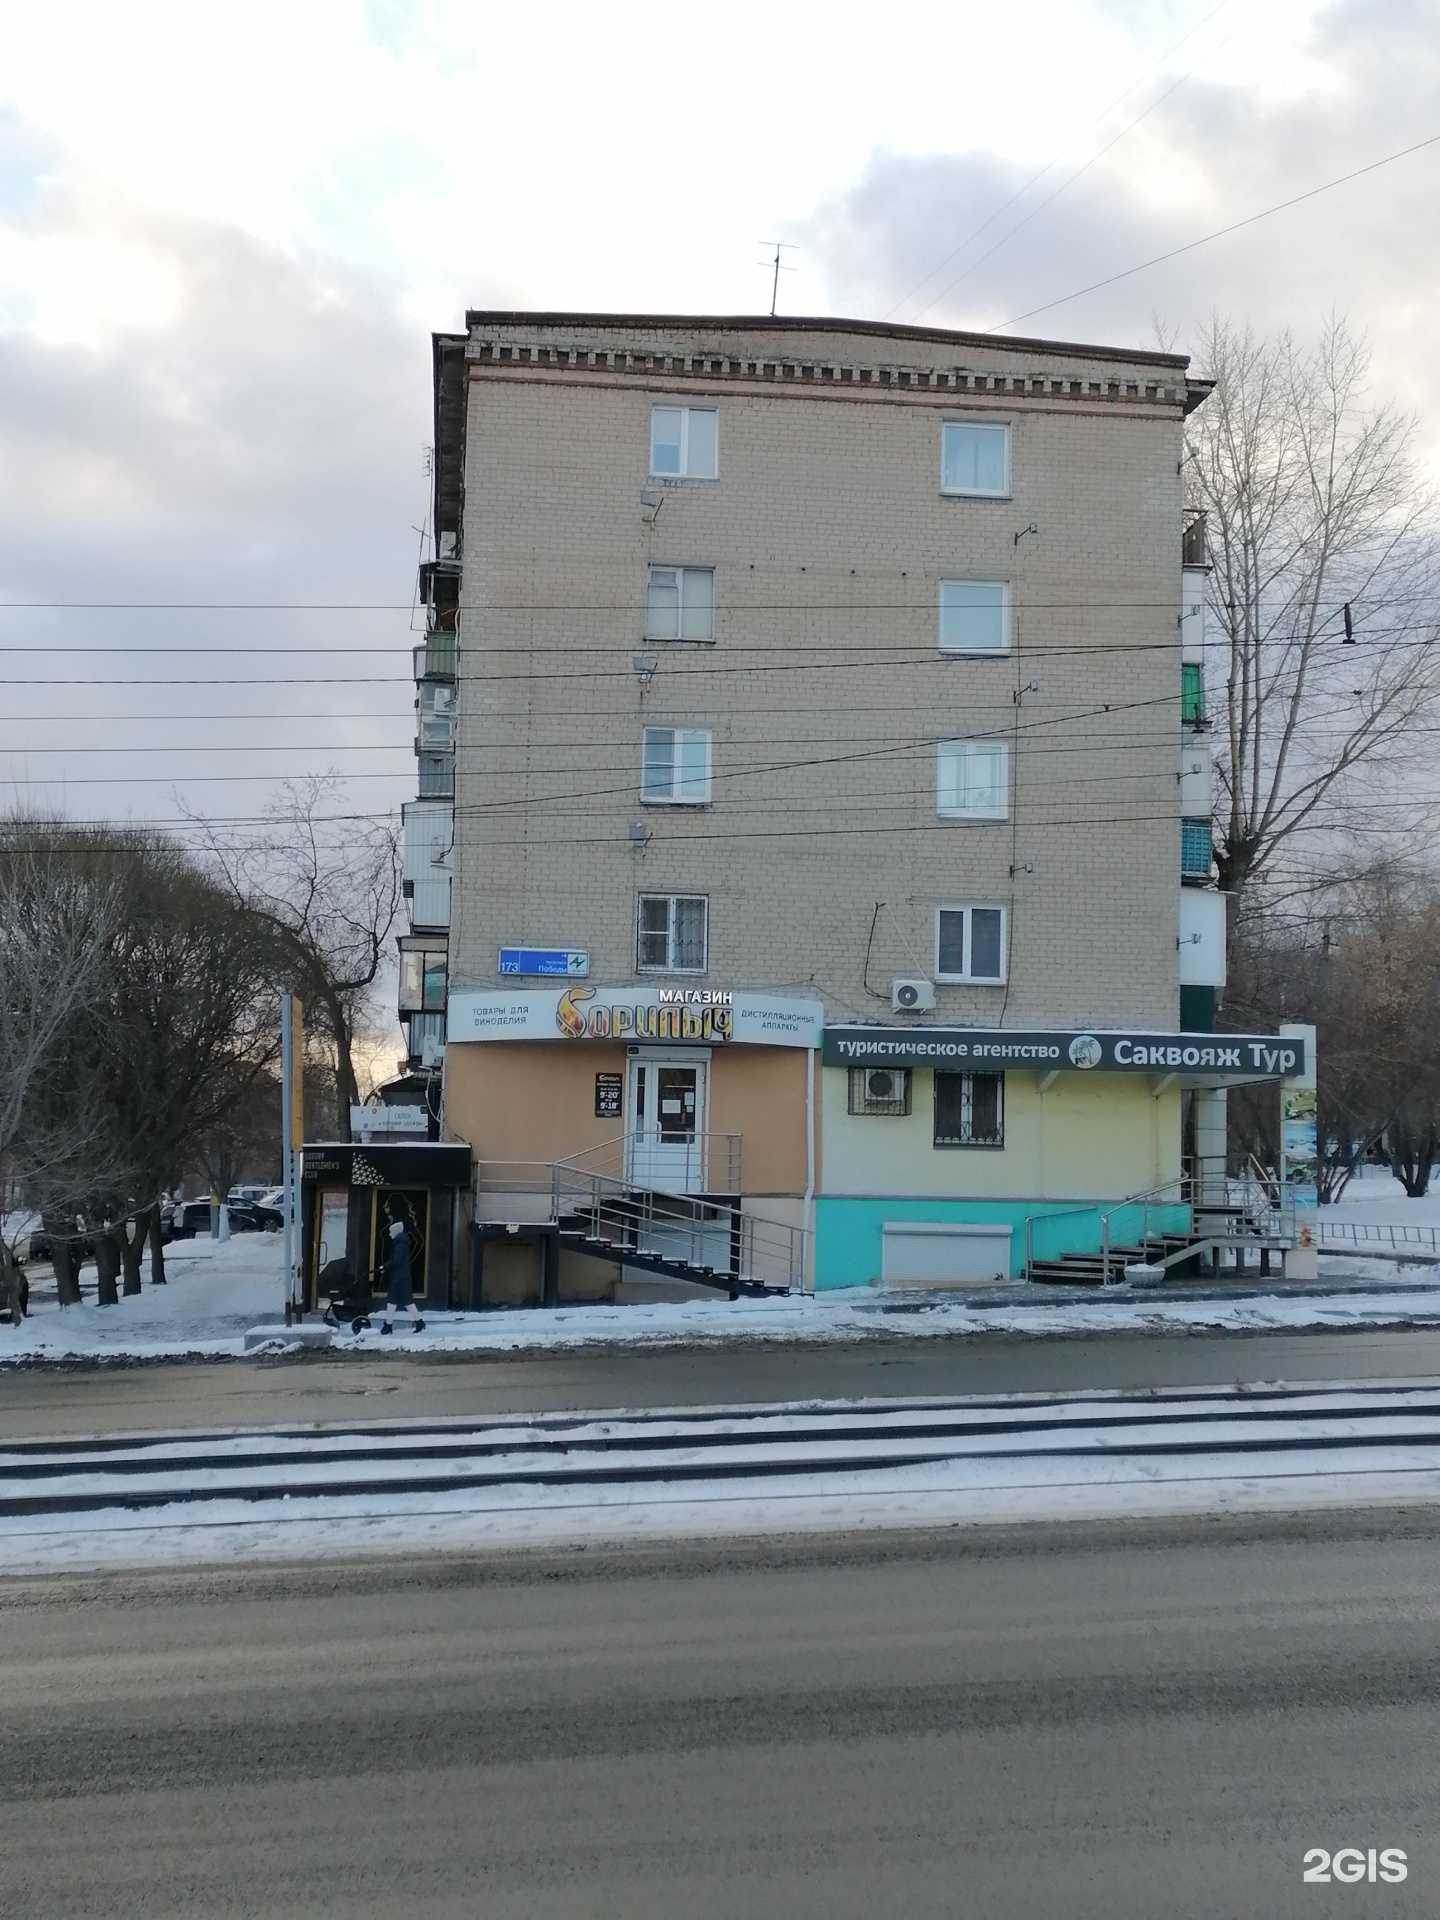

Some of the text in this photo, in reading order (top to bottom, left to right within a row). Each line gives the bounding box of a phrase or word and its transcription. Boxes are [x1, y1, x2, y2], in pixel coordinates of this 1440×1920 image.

[502, 961, 519, 972] 173
[659, 989, 733, 1004] МАГАЗИН
[472, 1006, 529, 1015] ТОВАРЫ ДЛЯ
[474, 1016, 526, 1025] ВИНОДЕЛИЯ
[761, 1021, 799, 1031] АППАРАТЫ
[837, 1040, 1060, 1058] туристическое агентство
[1114, 1040, 1296, 1073] Саквояж Тур
